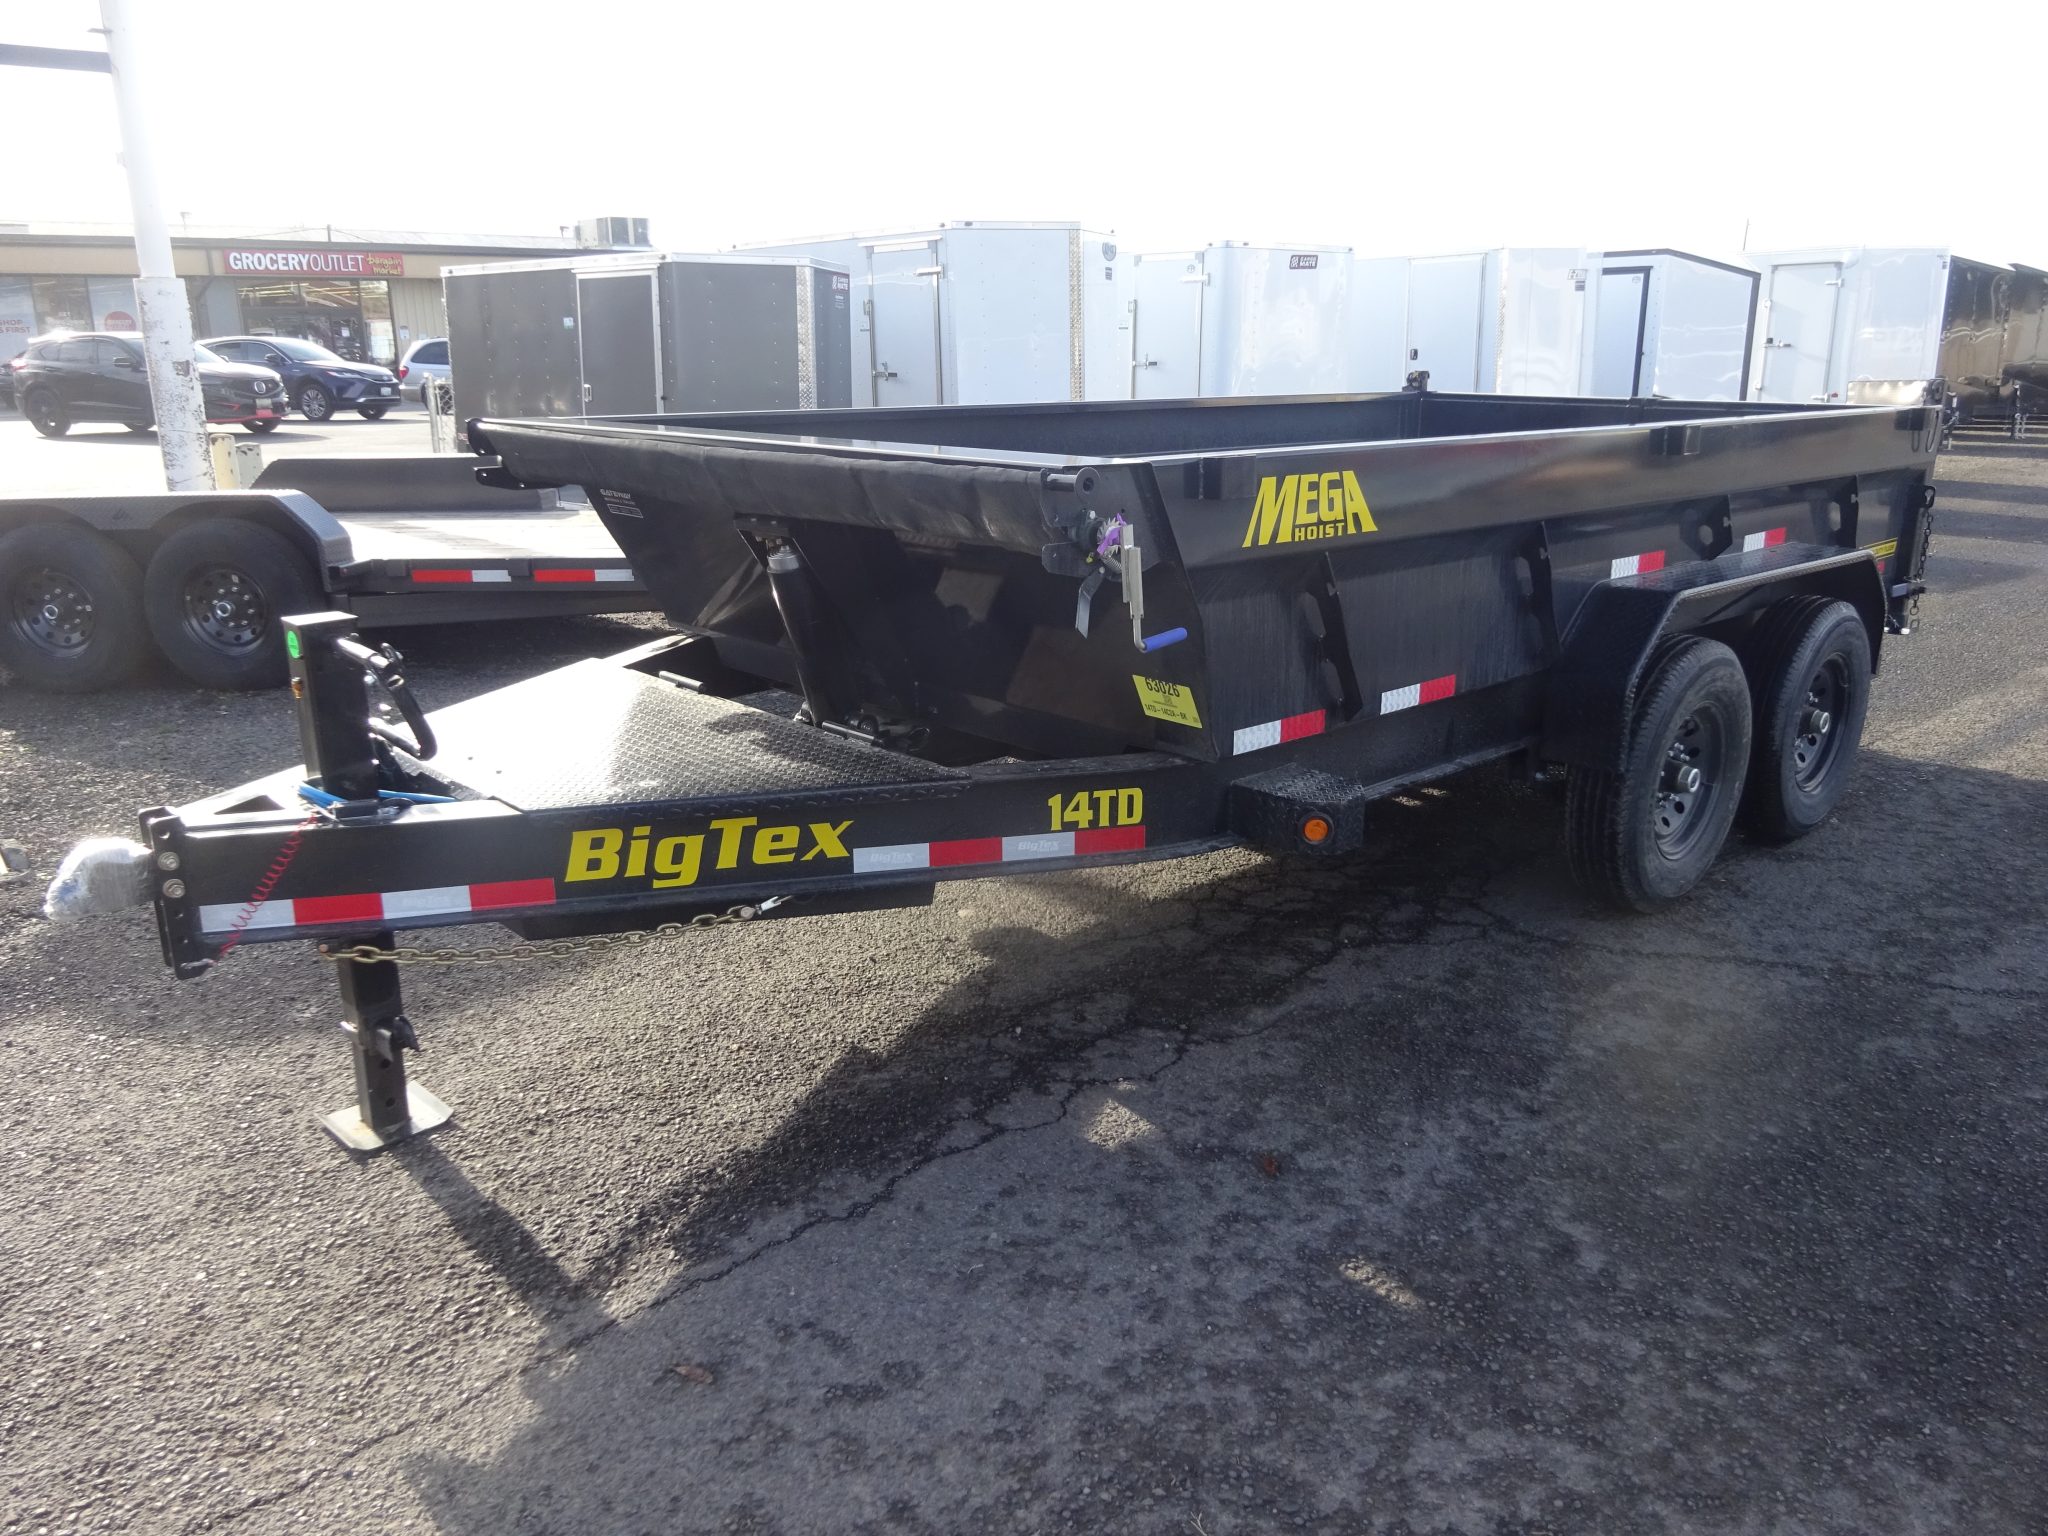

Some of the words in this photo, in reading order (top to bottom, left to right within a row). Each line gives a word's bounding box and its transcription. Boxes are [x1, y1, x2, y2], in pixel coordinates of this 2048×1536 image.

[1242, 470, 1378, 548] MEGA
[1294, 522, 1345, 542] HOIST
[1145, 677, 1181, 698] 63026
[1047, 787, 1143, 831] 14TD
[564, 816, 855, 889] BigTex
